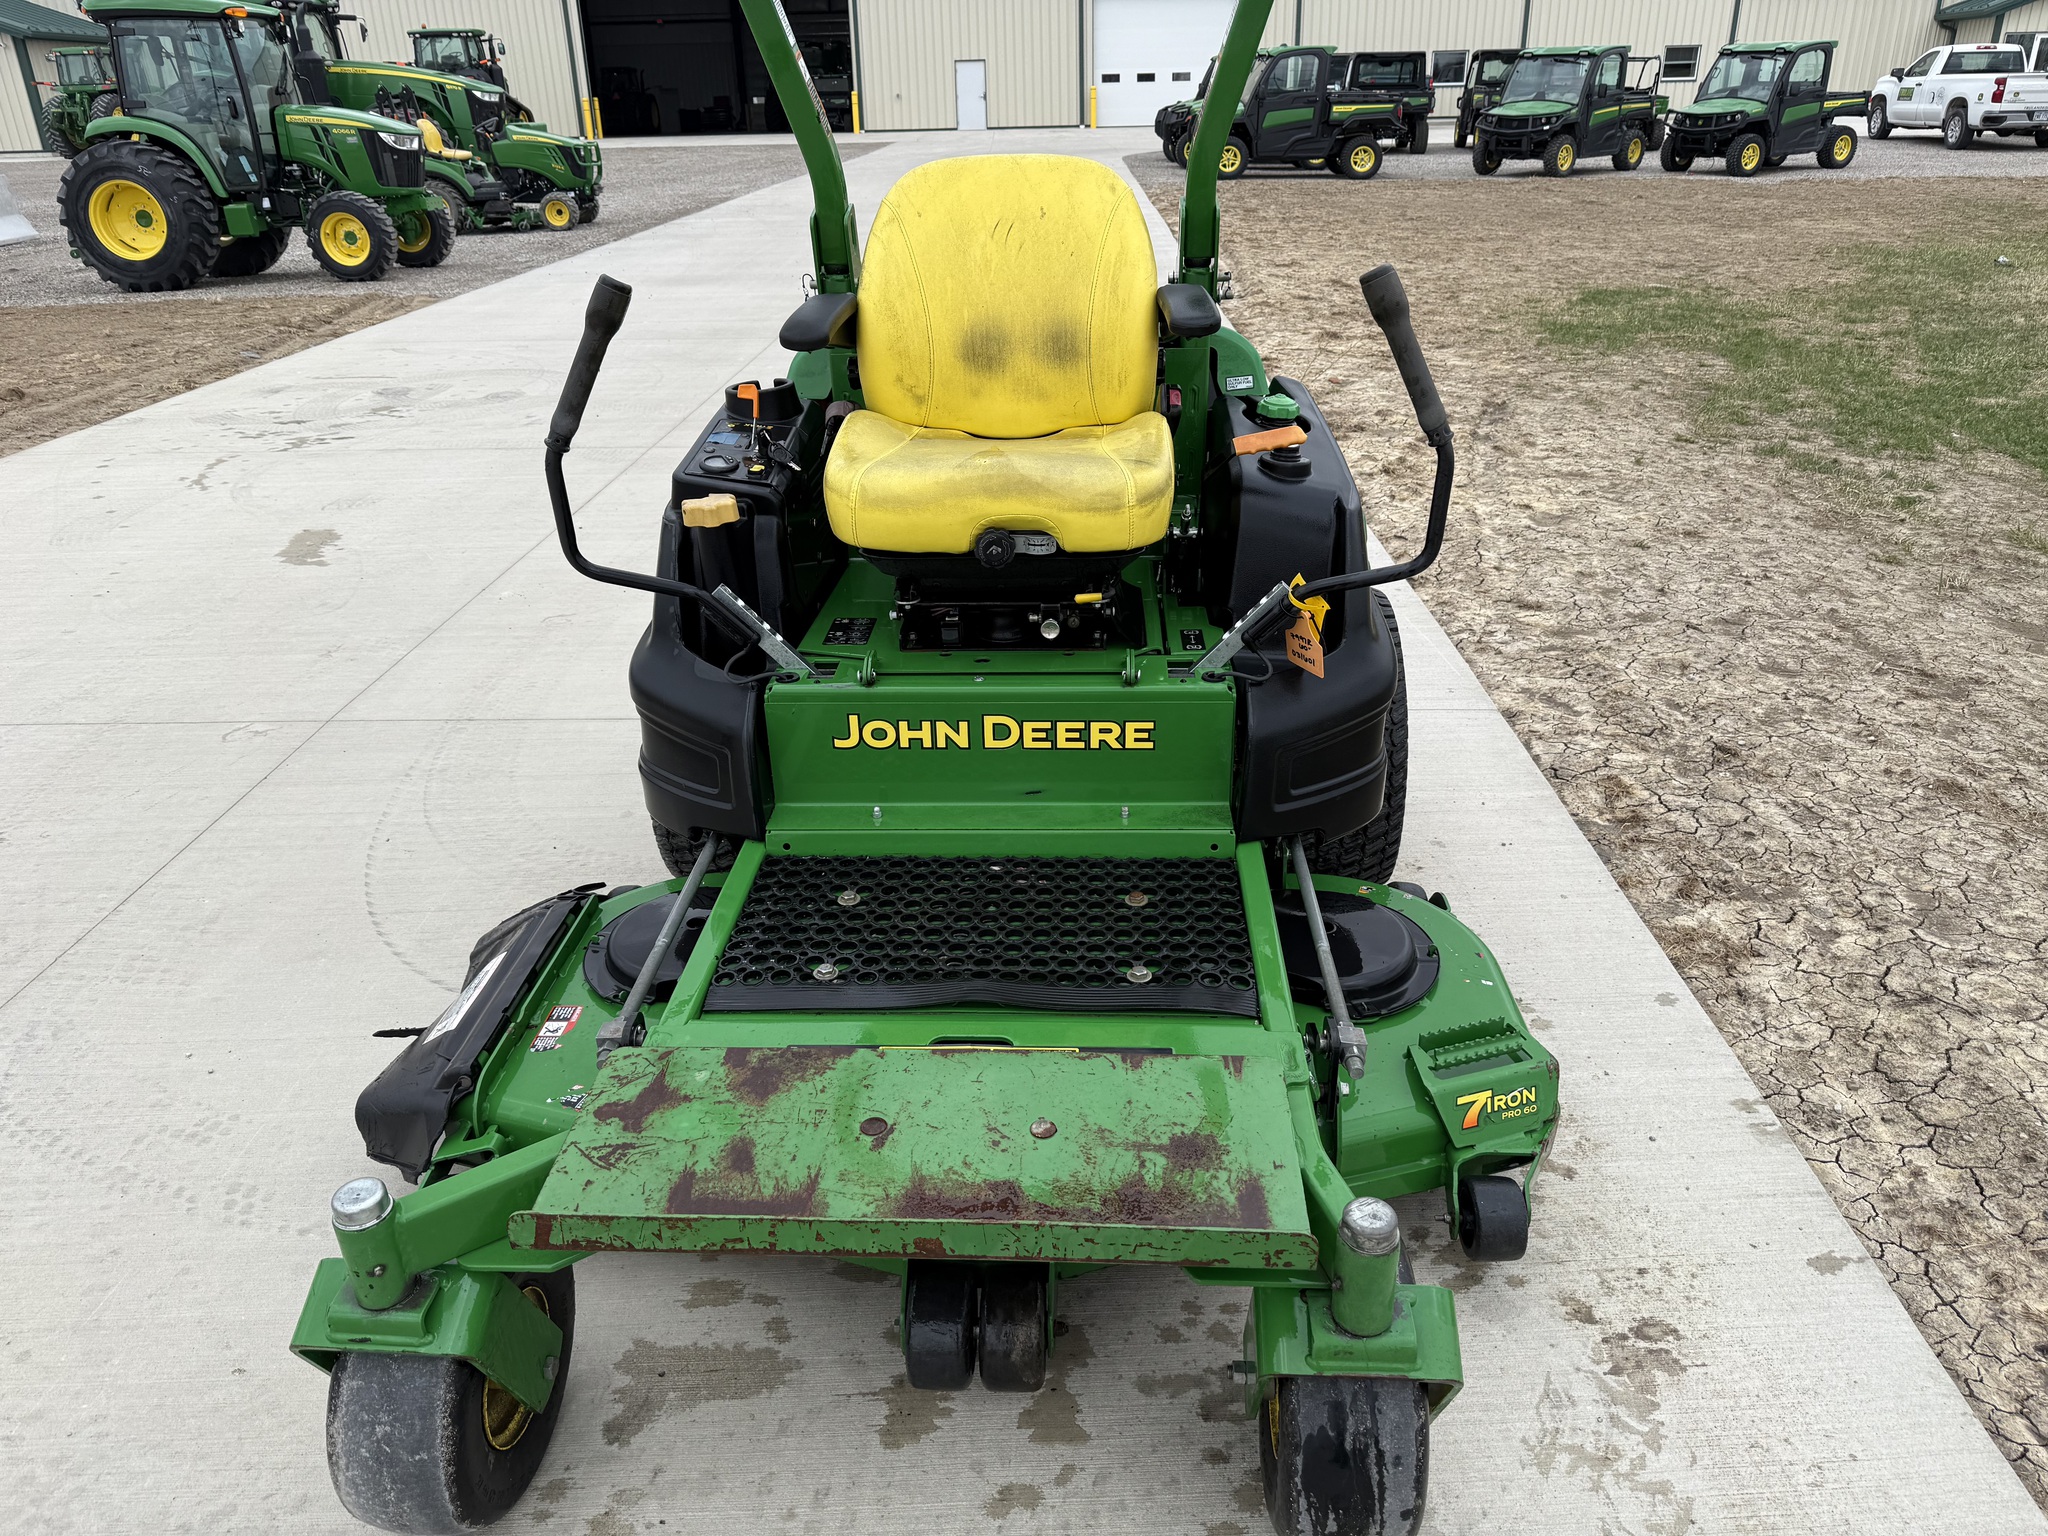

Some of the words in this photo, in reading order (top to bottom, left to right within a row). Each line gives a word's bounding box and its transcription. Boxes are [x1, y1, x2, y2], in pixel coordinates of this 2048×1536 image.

[832, 712, 972, 750] JOHN
[981, 714, 1156, 751] DEERE
[1501, 1108, 1522, 1120] PRO
[1523, 1104, 1538, 1114] 60
